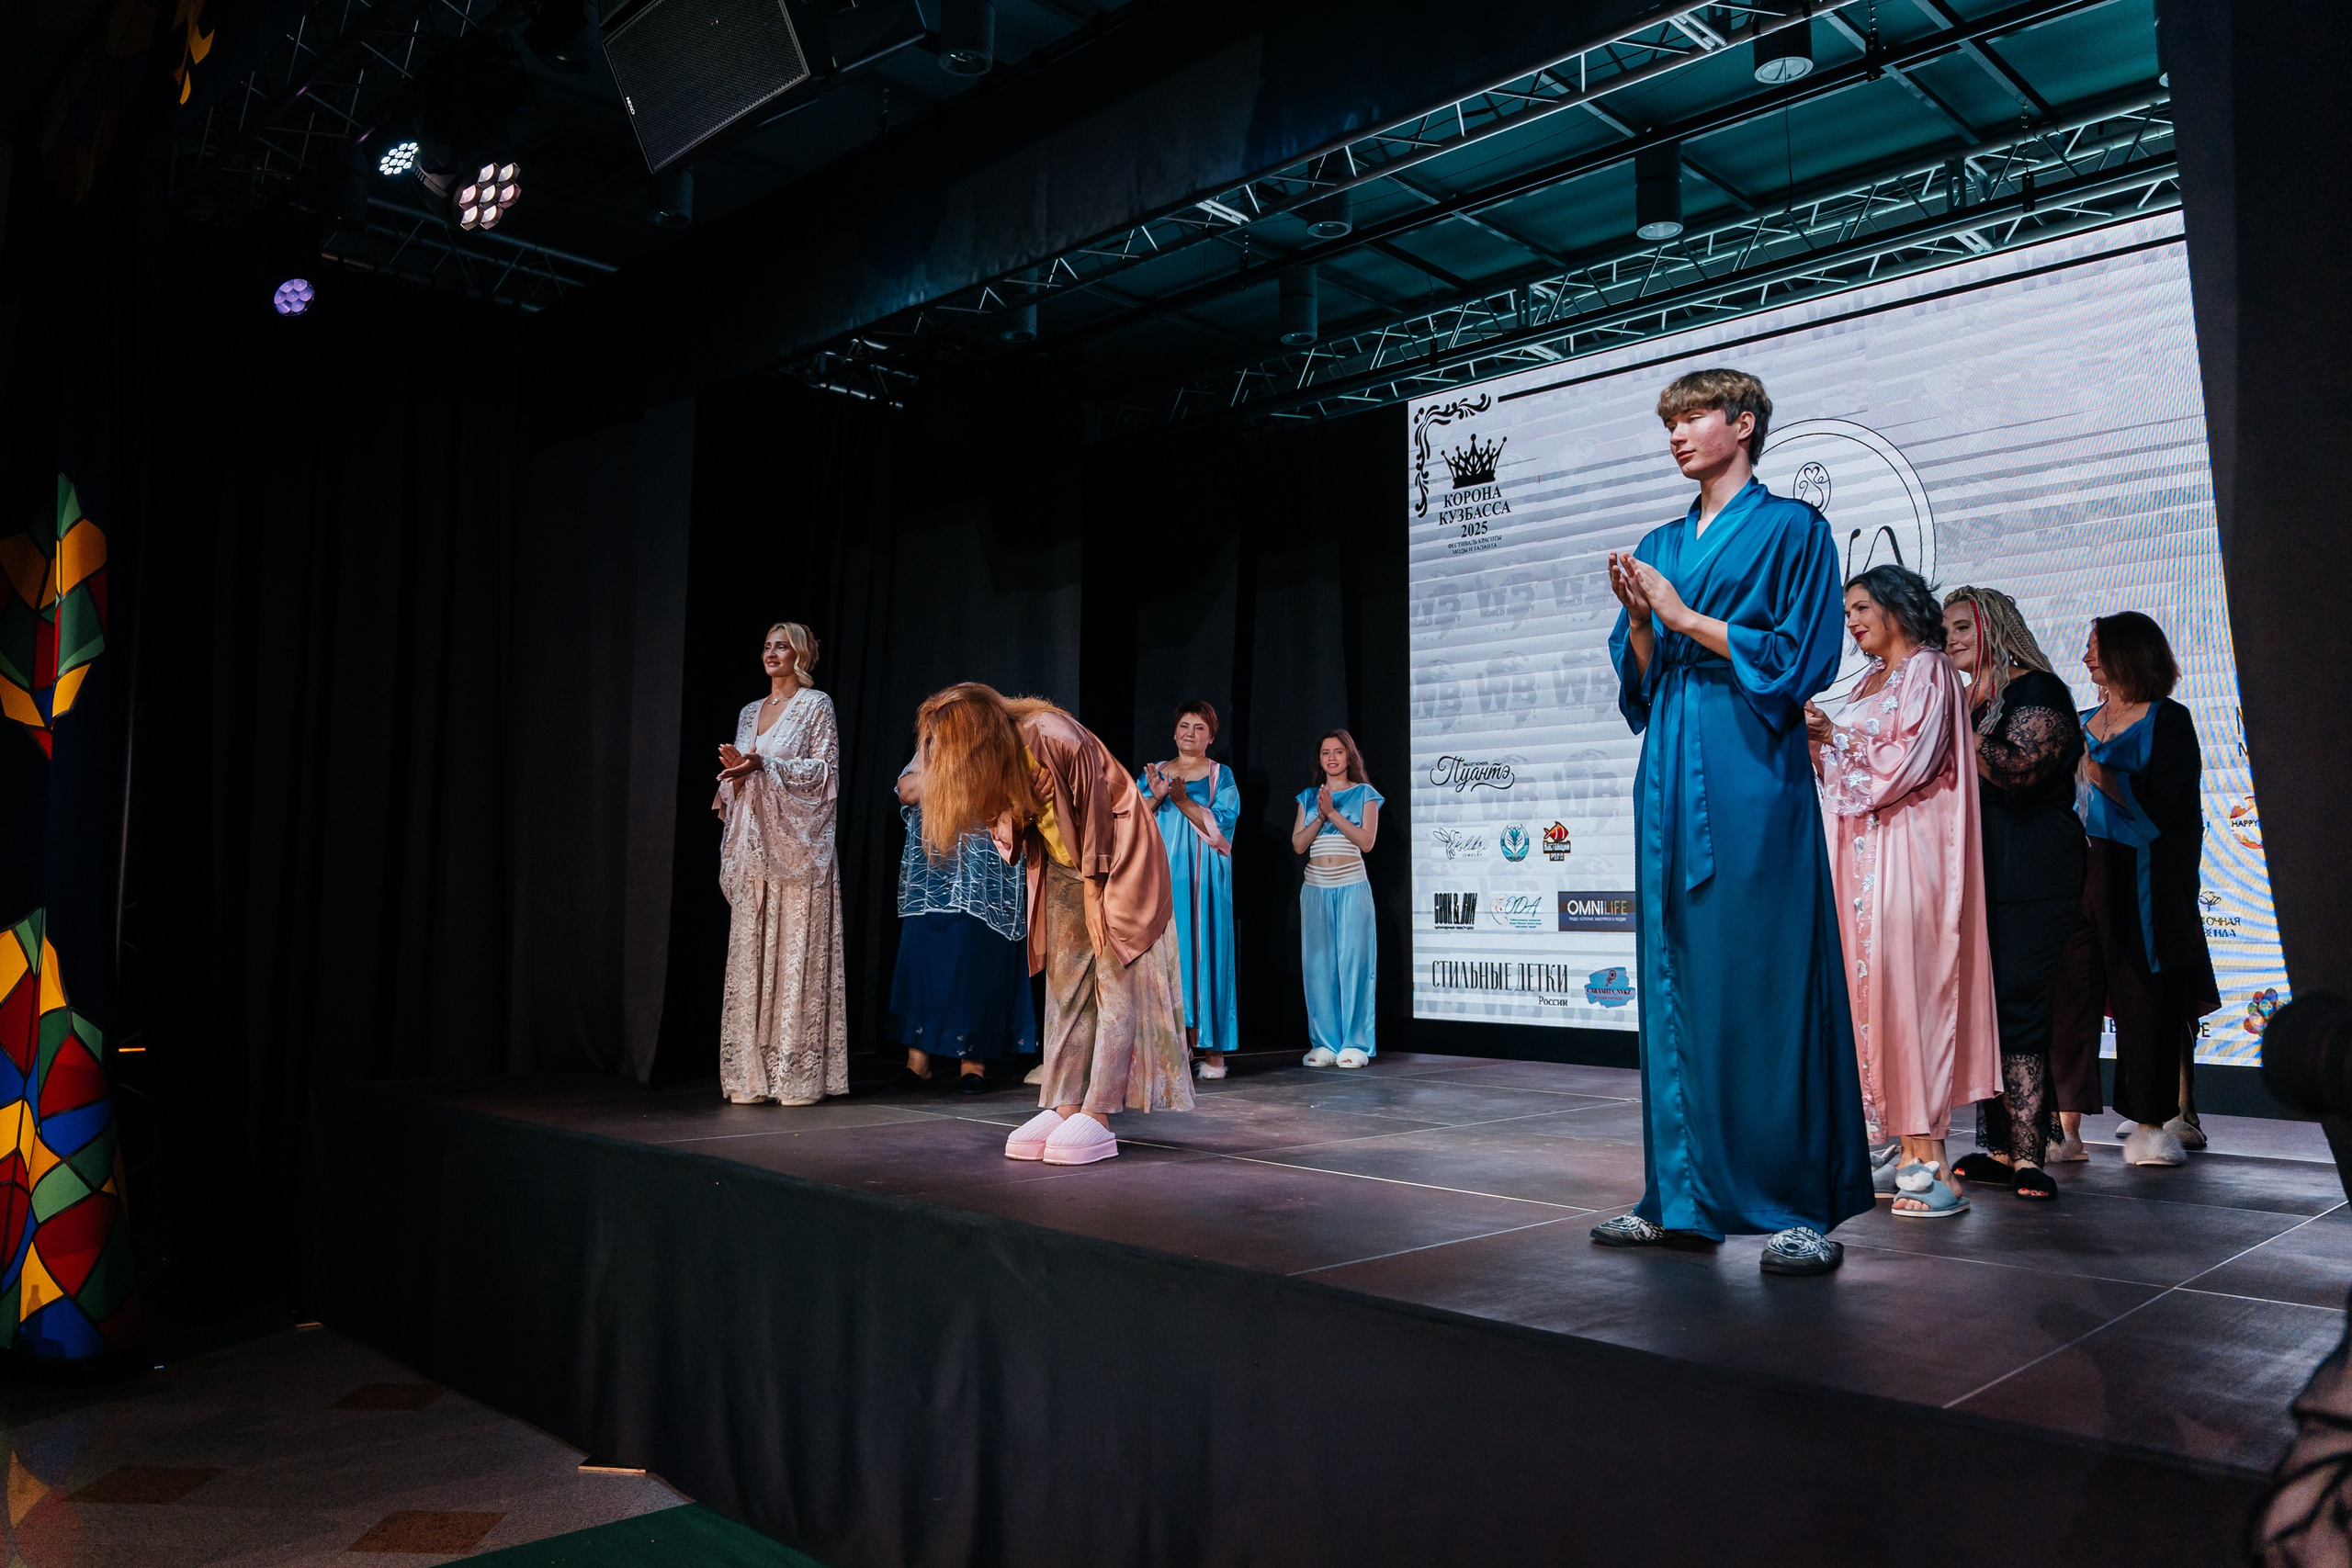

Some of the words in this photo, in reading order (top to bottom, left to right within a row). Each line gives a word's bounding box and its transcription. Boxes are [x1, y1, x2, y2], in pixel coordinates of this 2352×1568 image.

[626, 96, 635, 115] NEXO
[1443, 486, 1502, 508] КОРОНА
[1439, 501, 1511, 525] КУЗБАССА
[1461, 521, 1488, 537] 2025
[1448, 539, 1477, 549] ФЕСТИВАЛЬ
[1478, 535, 1502, 545] КРАСОТЫ
[1430, 756, 1514, 793] Пуантэ
[2231, 818, 2258, 828] HAPPY
[1566, 899, 1628, 916] OMNILIFE
[1431, 960, 1512, 991] СТИЛЬНЫЕ
[1514, 963, 1568, 994] ДЕТКИ
[1538, 996, 1568, 1007] России
